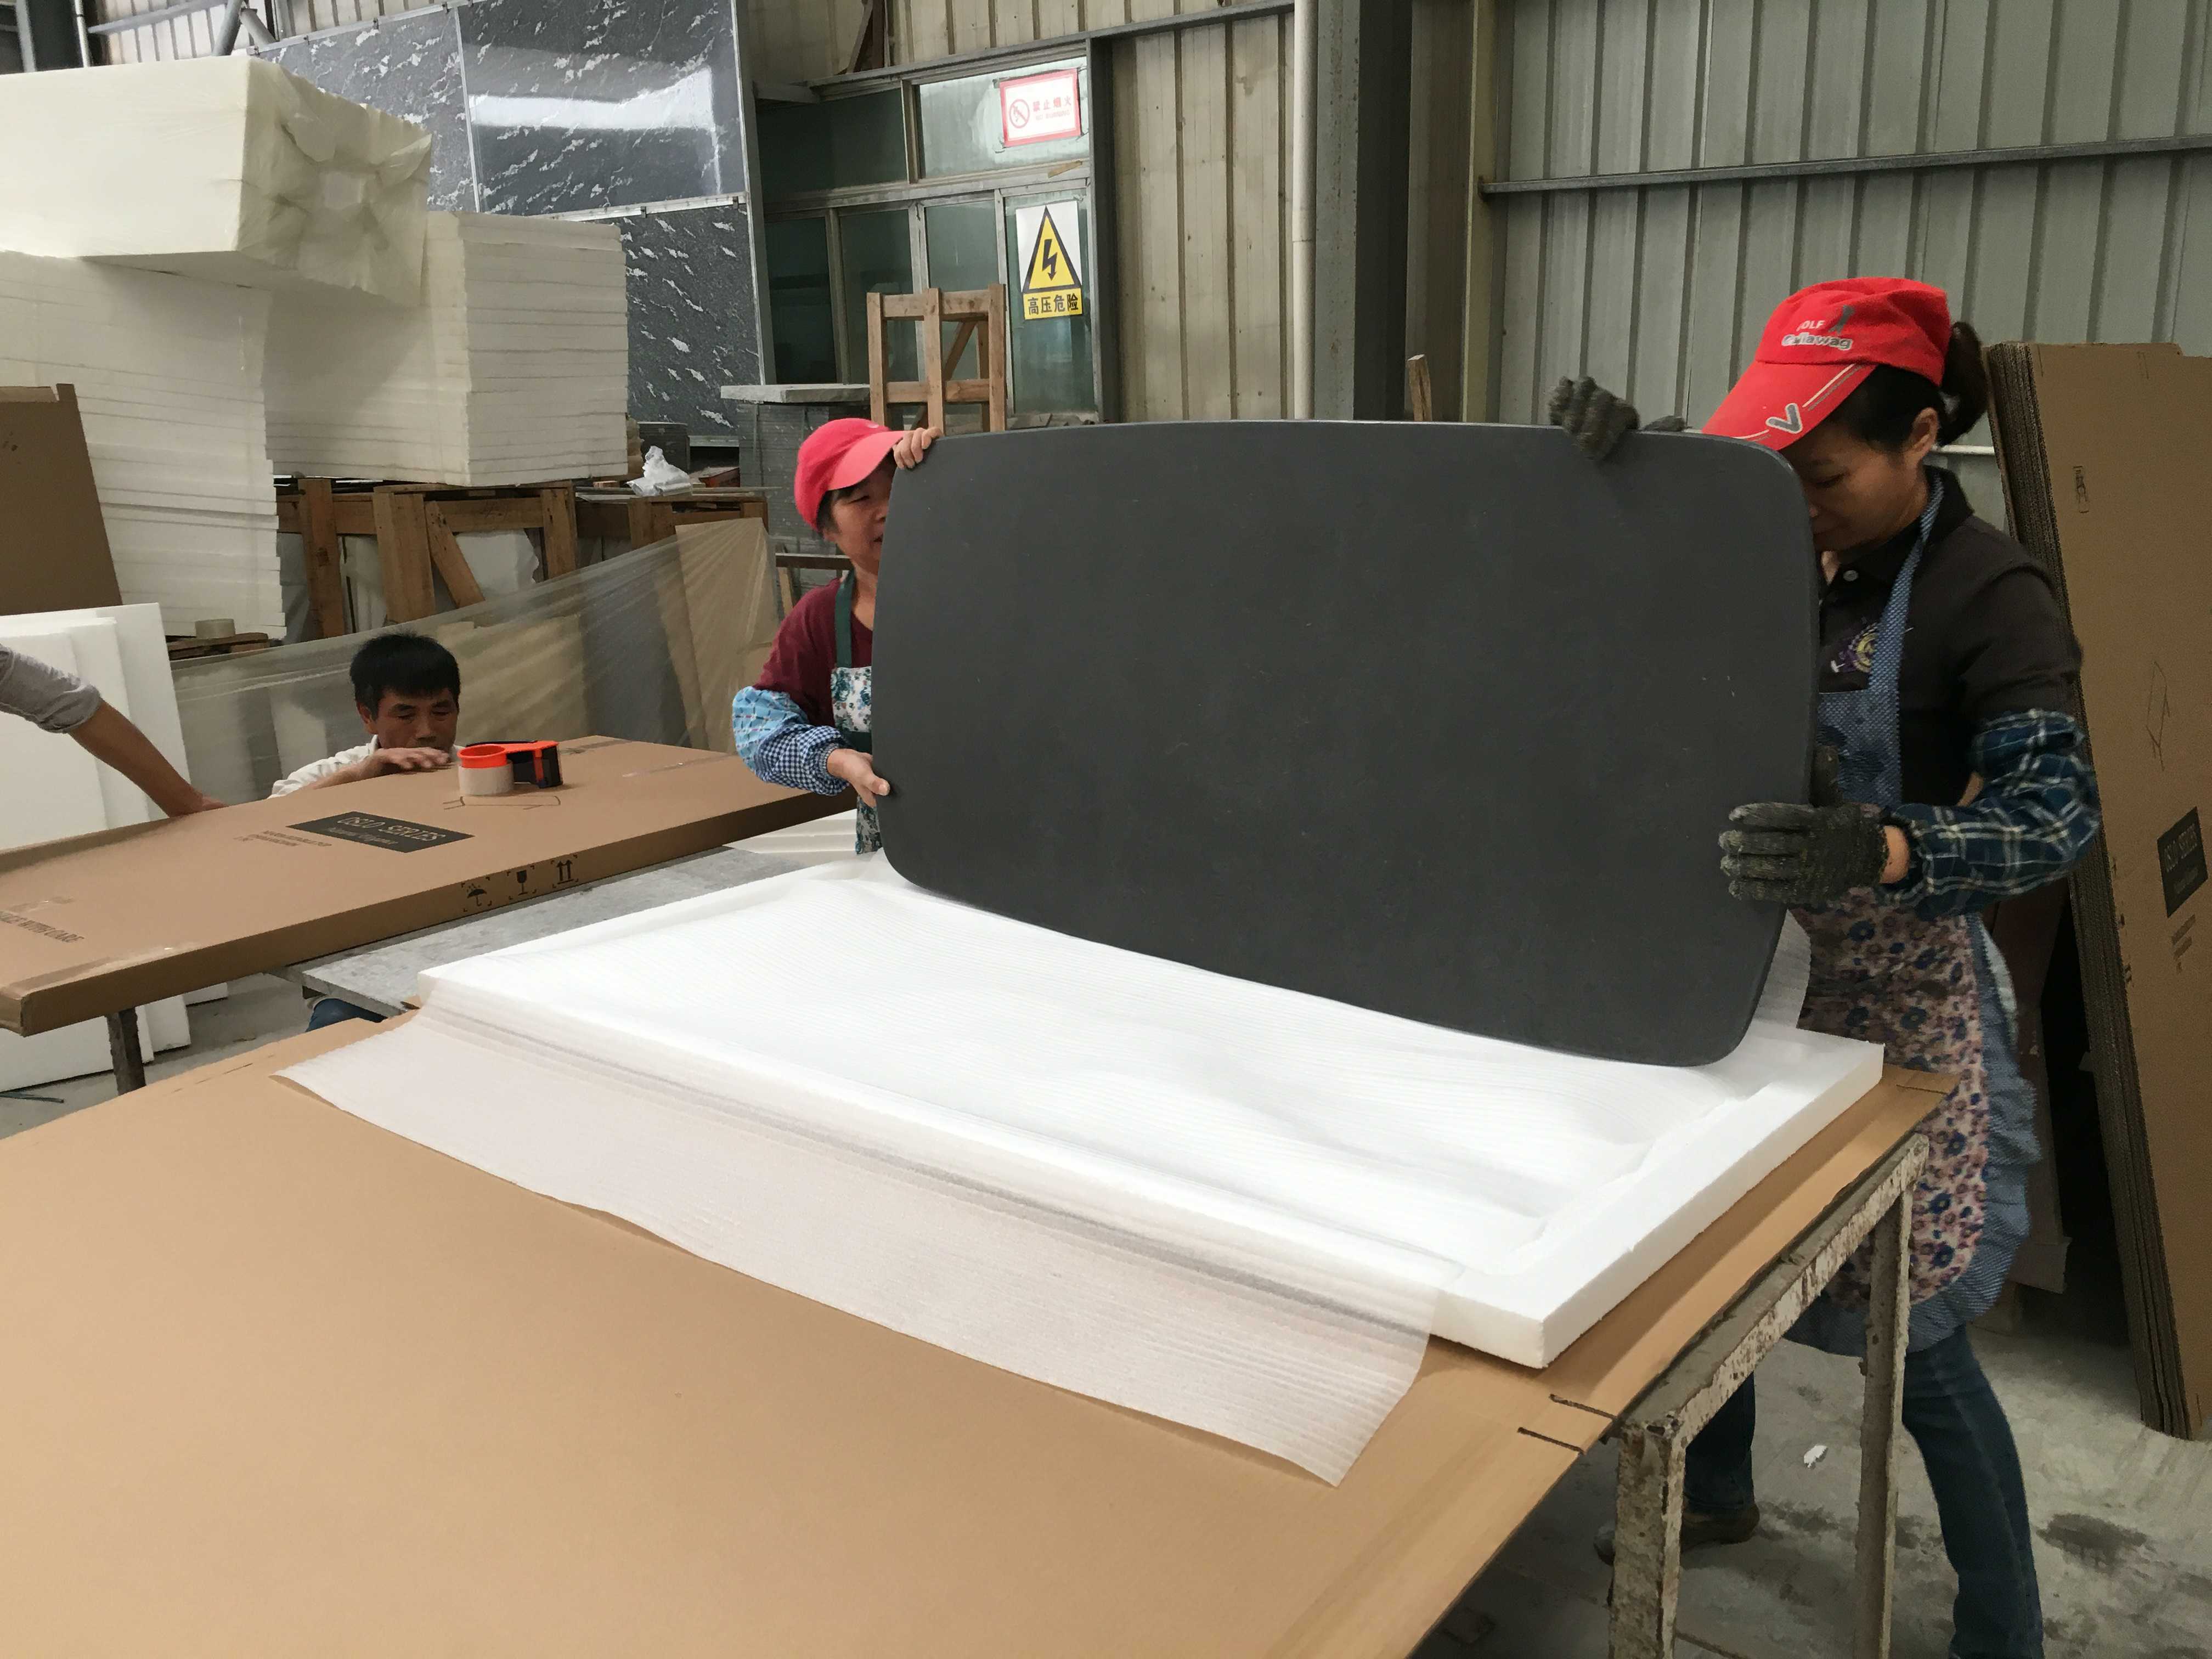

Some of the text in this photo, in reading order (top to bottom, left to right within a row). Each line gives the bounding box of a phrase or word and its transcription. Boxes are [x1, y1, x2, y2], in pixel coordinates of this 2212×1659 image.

[1028, 293, 1079, 315] 高压危险
[378, 825, 446, 842] SERIES
[43, 929, 85, 943] CARE
